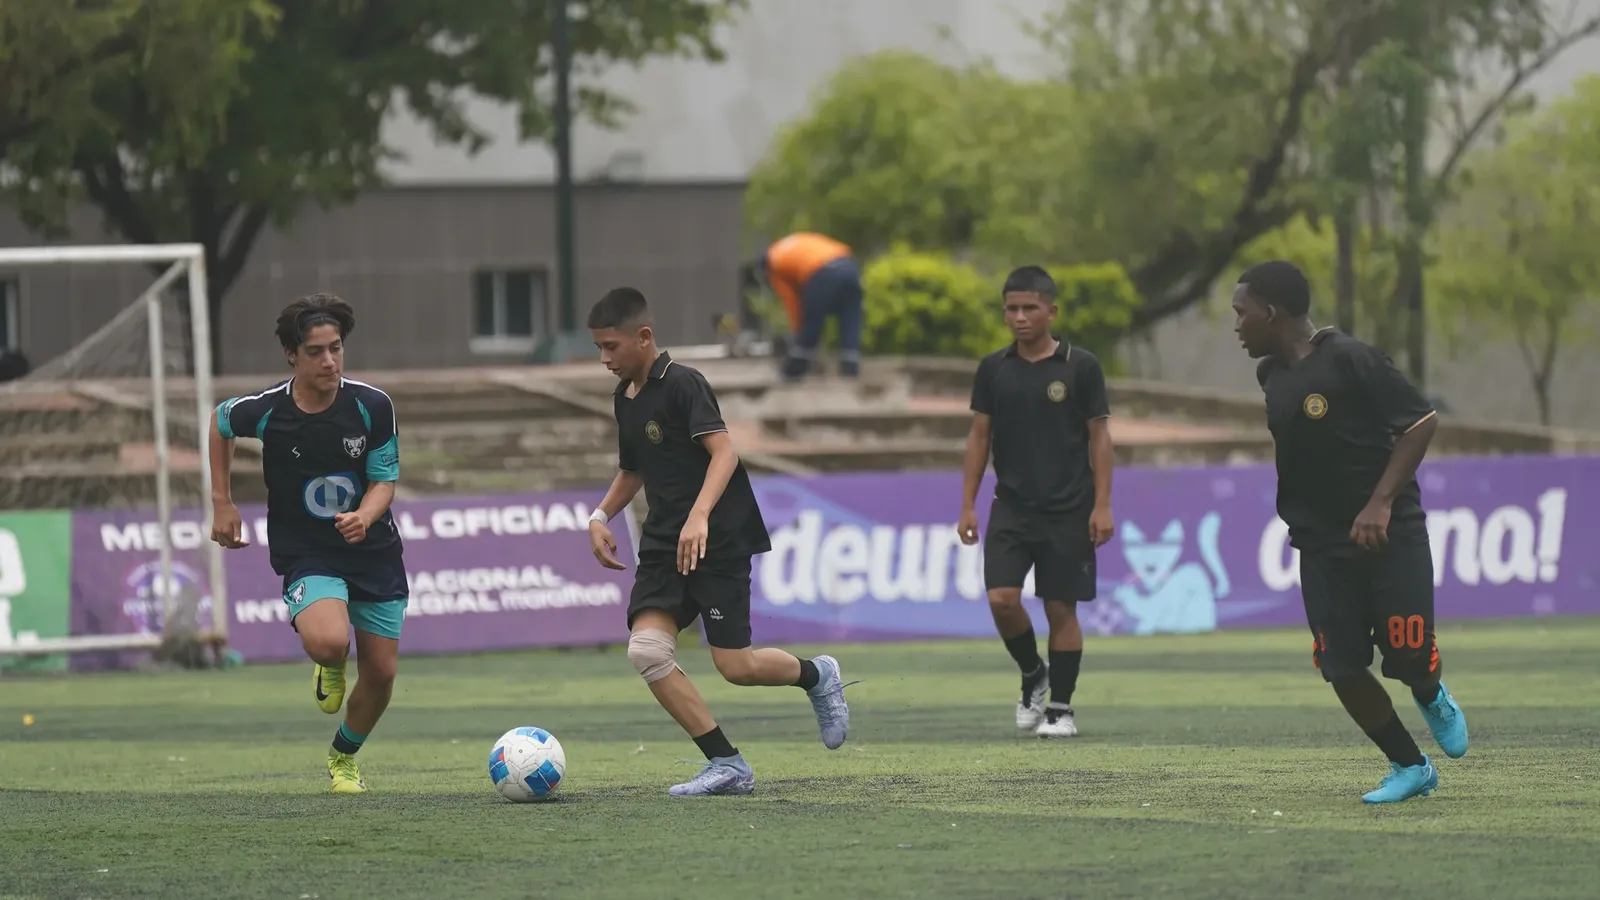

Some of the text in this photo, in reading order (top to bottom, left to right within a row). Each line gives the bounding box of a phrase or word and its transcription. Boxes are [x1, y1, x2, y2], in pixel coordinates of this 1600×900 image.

[100, 519, 249, 551] MED
[431, 502, 591, 539] OFICIAL
[759, 509, 1037, 605] deun
[1259, 487, 1566, 592] na!
[1388, 614, 1425, 649] 80
